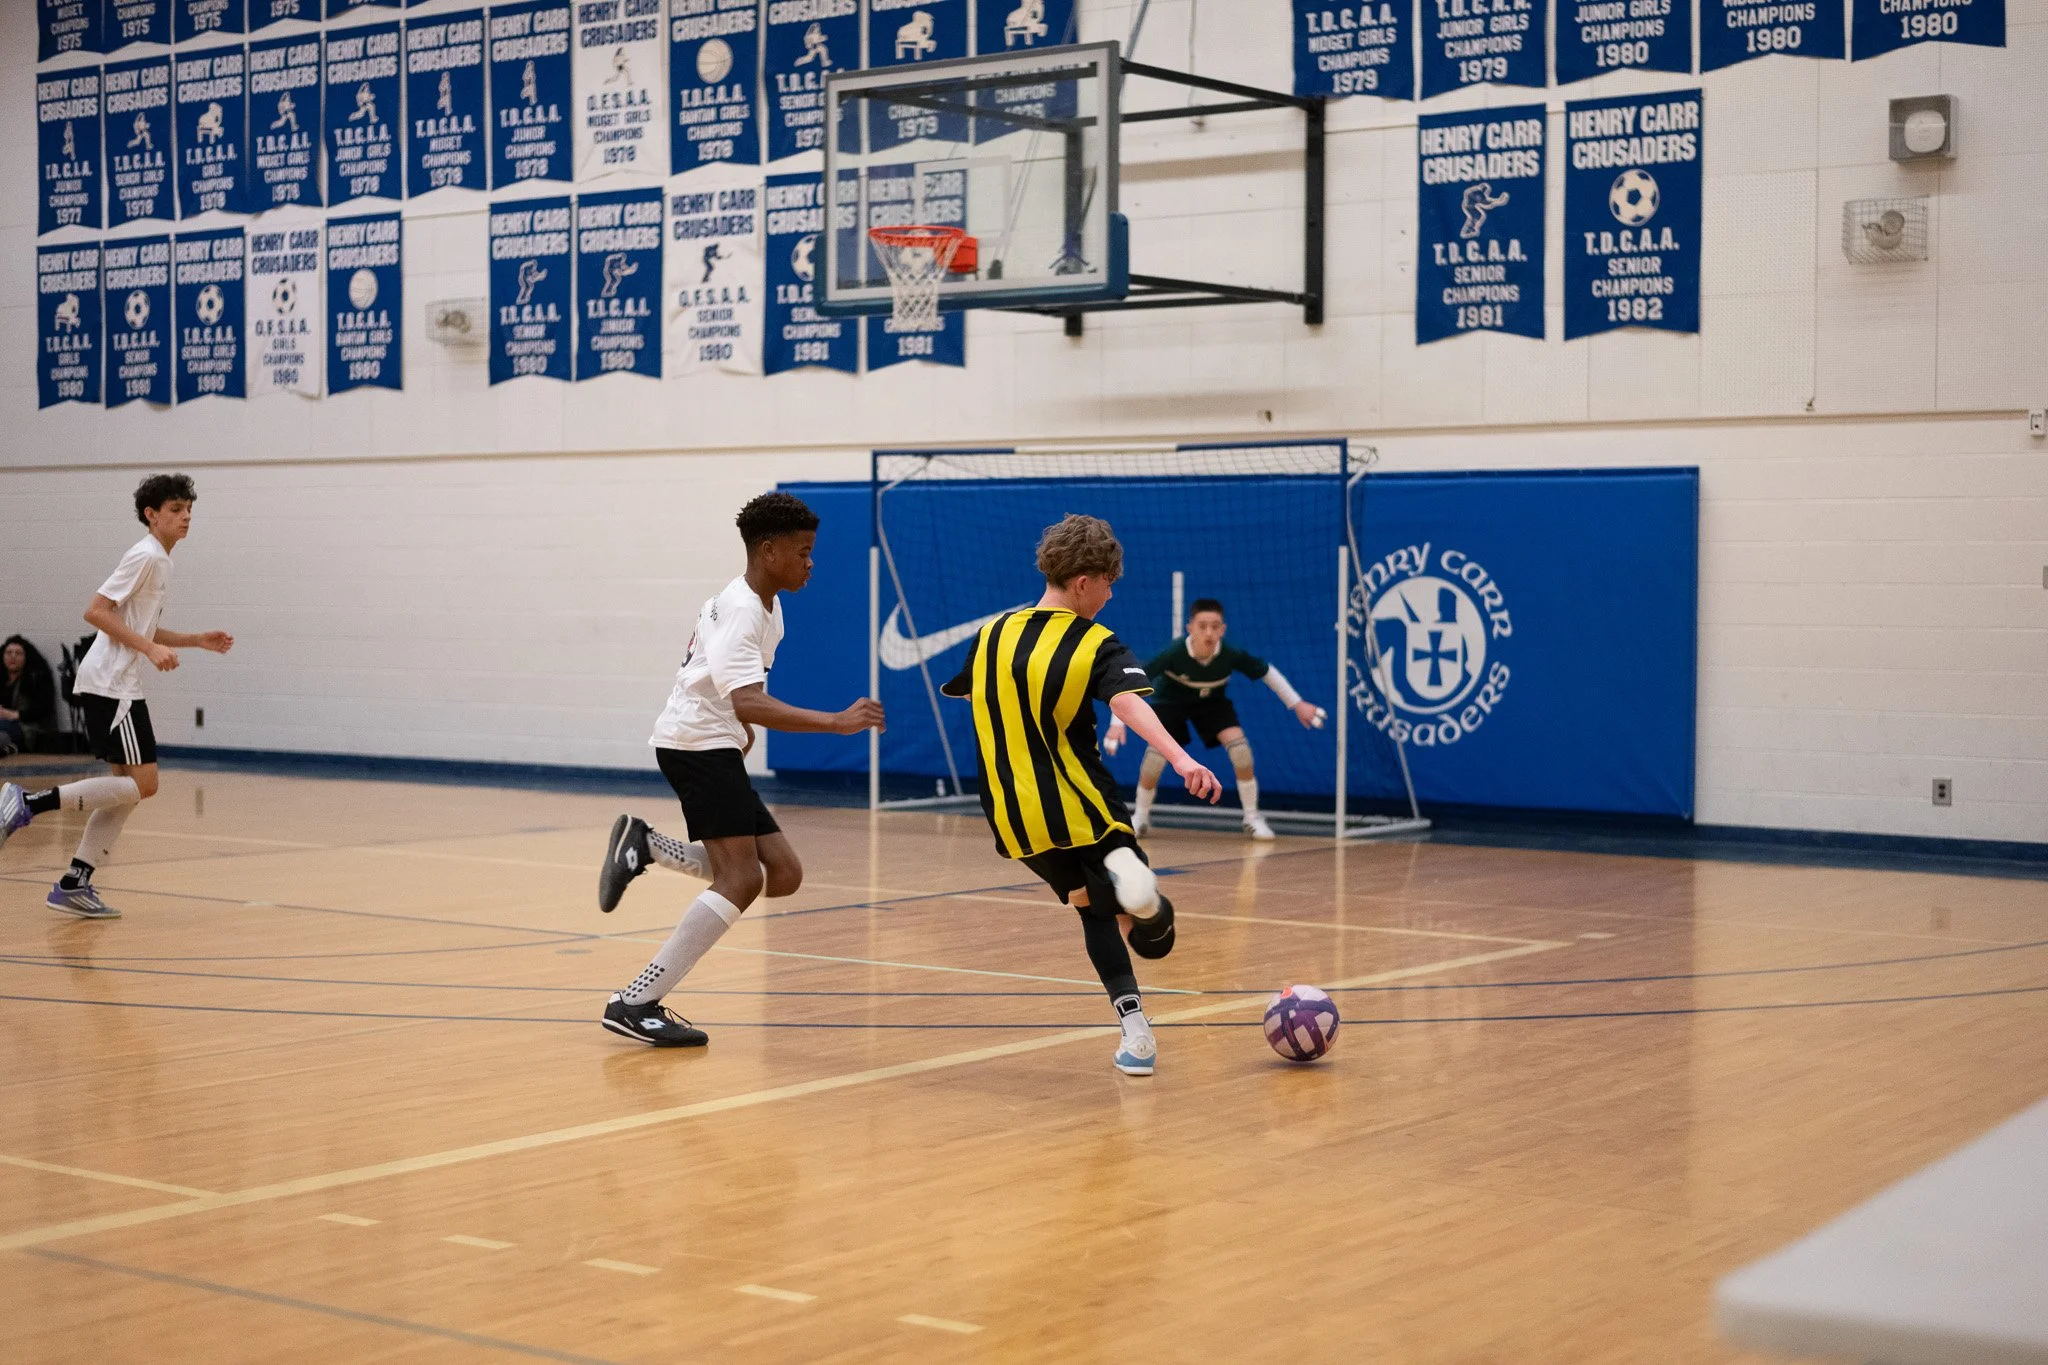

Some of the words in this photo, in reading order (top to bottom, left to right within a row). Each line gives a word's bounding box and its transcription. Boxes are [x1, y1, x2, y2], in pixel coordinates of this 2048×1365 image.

[117, 3, 156, 20] CHAMPIONS
[270, 0, 300, 17] 1975
[578, 2, 618, 24] HENRY
[624, 0, 659, 17] CARR
[768, 0, 857, 26] CRUSADERS
[1306, 4, 1398, 34] T.D.C.A.A.
[1574, 2, 1624, 24] JUNIOR
[1630, 0, 1671, 18] GIRLS
[1726, 4, 1816, 28] CHAMPIONS
[51, 18, 89, 34] CHAMPIONS
[122, 18, 150, 38] 1975
[194, 13, 222, 31] 1975
[491, 12, 533, 39] HENRY
[534, 8, 570, 32] CARR
[581, 19, 657, 48] CRUSADERS
[672, 10, 756, 42] CRUSADERS
[1436, 18, 1484, 40] JUNIOR
[1490, 14, 1530, 33] GIRLS
[1582, 19, 1664, 44] CHAMPIONS
[1901, 12, 1958, 38] 1980
[57, 33, 82, 50] 1975
[327, 38, 365, 62] HENRY
[366, 32, 398, 56] CARR
[407, 24, 448, 51] HENRY
[448, 20, 482, 44] CARR
[492, 32, 568, 62] CRUSADERS
[1308, 32, 1354, 53] MIDGET
[1358, 28, 1396, 46] GIRLS
[1444, 34, 1522, 58] CHAMPIONS
[1746, 26, 1802, 52] 1980
[250, 48, 286, 71] HENRY
[288, 43, 319, 66] CARR
[408, 44, 481, 74] CRUSADERS
[1318, 48, 1390, 72] CHAMPIONS
[1596, 41, 1649, 68] 1980
[105, 70, 138, 93] HENRY
[141, 65, 170, 84] CARR
[177, 58, 212, 82] HENRY
[213, 54, 243, 76] CARR
[251, 65, 318, 94] CRUSADERS
[328, 55, 398, 85] CRUSADERS
[1460, 57, 1508, 83] 1979
[38, 80, 70, 102] HENRY
[71, 76, 98, 96] CARR
[178, 76, 242, 104] CRUSADERS
[1332, 69, 1378, 94] 1979
[40, 97, 98, 122] CRUSADERS
[107, 86, 168, 114] CRUSADERS
[780, 94, 817, 110] SENIOR
[624, 110, 650, 125] GIRLS
[1570, 106, 1636, 139] HENRY
[1640, 101, 1699, 132] CARR
[512, 125, 546, 142] JUNIOR
[594, 127, 644, 144] CHAMPIONS
[687, 122, 743, 141] CHAMPIONS
[1420, 124, 1484, 155] HENRY
[1486, 119, 1542, 149] CARR
[429, 136, 463, 152] MIDGET
[505, 141, 556, 160] CHAMPIONS
[1573, 133, 1696, 170] CRUSADERS
[339, 159, 388, 176] CHAMPIONS
[422, 150, 472, 169] CHAMPIONS
[1423, 150, 1540, 185] CRUSADERS
[192, 176, 234, 193] CHAMPIONS
[264, 166, 308, 184] CHAMPIONS
[50, 193, 88, 208] CHAMPIONS
[119, 184, 159, 200] CHAMPIONS
[672, 192, 714, 216] HENRY
[719, 189, 755, 210] CARR
[767, 184, 814, 210] HENRY
[55, 207, 82, 225] 1977
[492, 211, 534, 237] HENRY
[533, 208, 570, 232] CARR
[579, 204, 624, 229] HENRY
[624, 201, 662, 226] CARR
[328, 224, 368, 248] HENRY
[366, 220, 399, 243] CARR
[580, 226, 660, 254] CRUSADERS
[673, 215, 754, 241] CRUSADERS
[176, 240, 211, 262] HENRY
[212, 237, 244, 260] CARR
[252, 233, 284, 252] HENRY
[290, 230, 318, 249] CARR
[493, 232, 570, 260] CRUSADERS
[1433, 239, 1528, 266] T.D.C.A.A.
[1584, 227, 1680, 255] T.D.C.A.A.
[39, 252, 70, 273] HENRY
[71, 250, 99, 270] CARR
[105, 246, 139, 269] HENRY
[140, 243, 169, 264] CARR
[252, 253, 316, 276] CRUSADERS
[328, 244, 398, 271] CRUSADERS
[1608, 257, 1661, 276] SENIOR
[40, 271, 96, 294] CRUSADERS
[106, 265, 168, 290] CRUSADERS
[177, 260, 242, 285] CRUSADERS
[1454, 265, 1505, 284] SENIOR
[1443, 284, 1520, 305] CHAMPIONS
[1592, 277, 1674, 298] CHAMPIONS
[697, 308, 734, 322] SENIOR
[1456, 305, 1503, 329] 1981
[1608, 299, 1662, 321] 1982
[513, 324, 546, 340] SENIOR
[591, 334, 644, 350] CHAMPIONS
[688, 324, 740, 339] CHAMPIONS
[783, 323, 841, 340] CHAMPIONS
[341, 345, 386, 361] CHAMPIONS
[505, 339, 556, 356] CHAMPIONS
[119, 363, 158, 379] CHAMPIONS
[188, 359, 232, 374] CHAMPIONS
[263, 354, 304, 366] CHAMPIONS
[51, 366, 88, 380] CHAMPIONS
